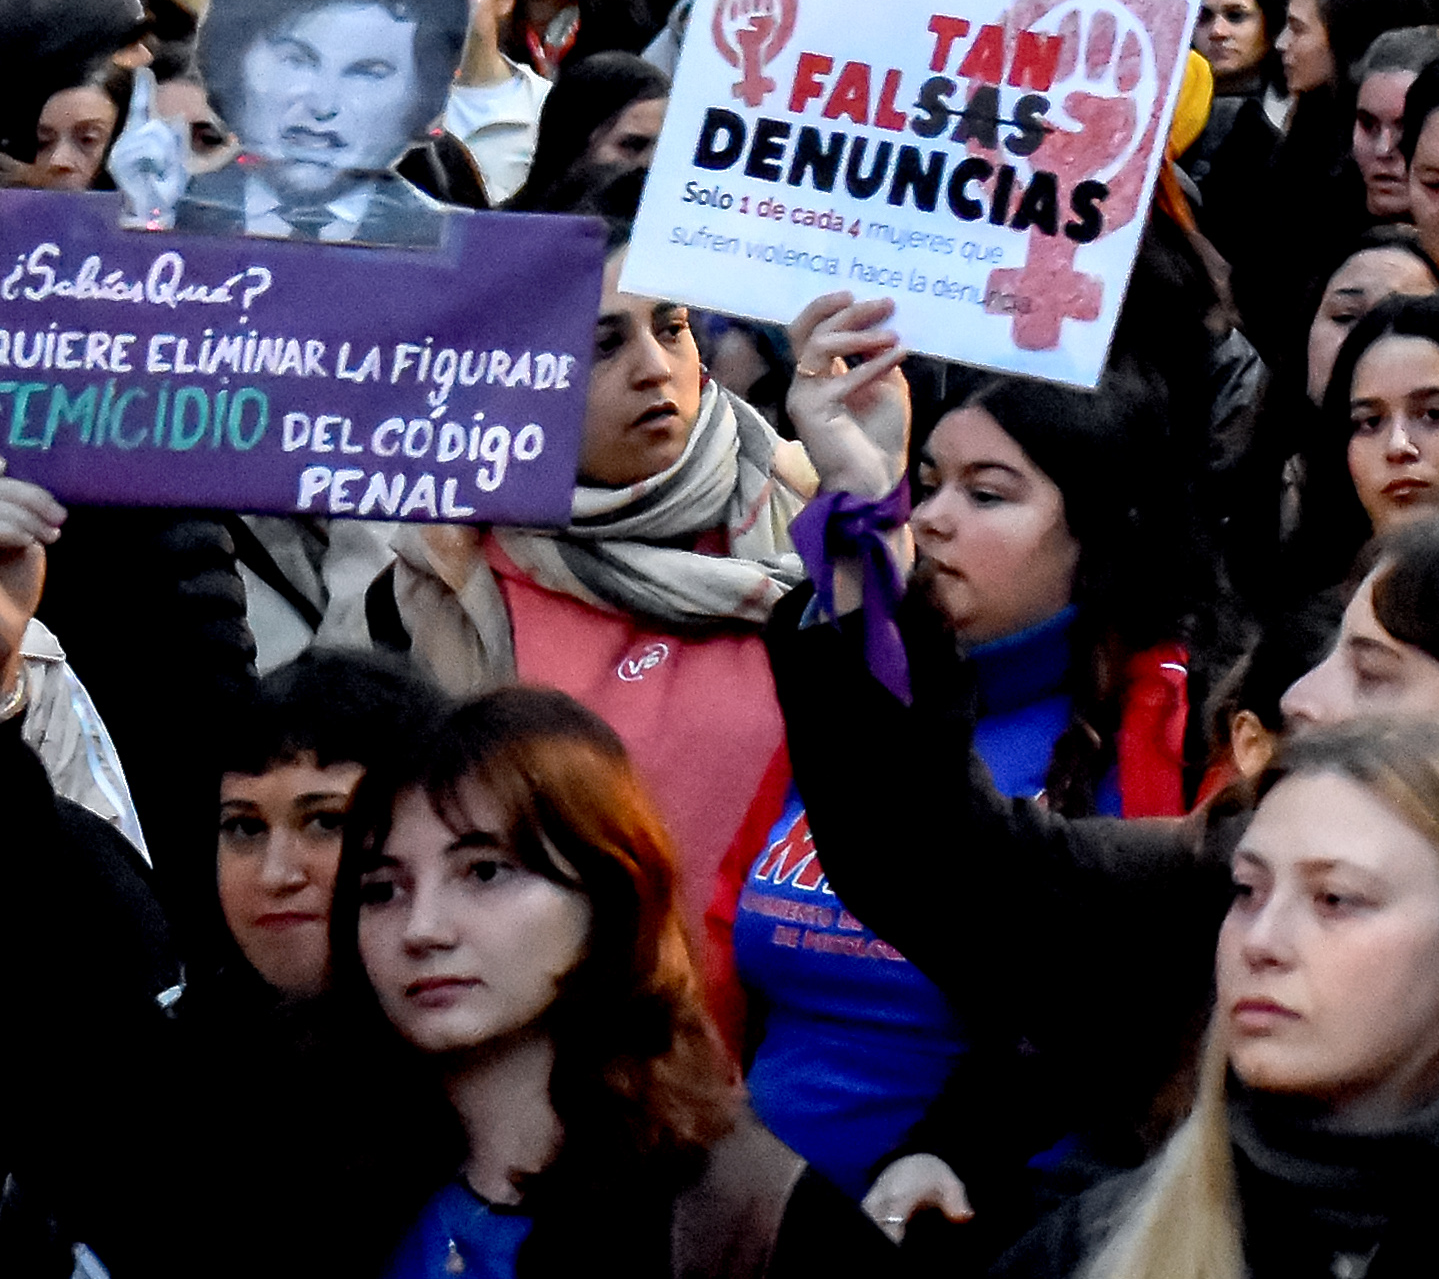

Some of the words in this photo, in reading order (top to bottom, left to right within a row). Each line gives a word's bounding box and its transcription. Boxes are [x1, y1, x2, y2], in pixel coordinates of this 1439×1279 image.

[927, 14, 1065, 92] TAN
[787, 51, 1052, 158] FALSAS
[691, 105, 1112, 243] DENUNCIAS
[682, 179, 735, 211] Solo
[738, 195, 751, 215] 1
[756, 195, 786, 222] de
[790, 204, 846, 234] cada
[847, 217, 862, 239] 4
[960, 240, 1005, 265] que
[335, 342, 381, 383] LA
[532, 352, 577, 391] DE
[0, 377, 270, 451] EMICIDIO
[281, 411, 364, 455] DEL
[297, 466, 478, 519] PENAL
